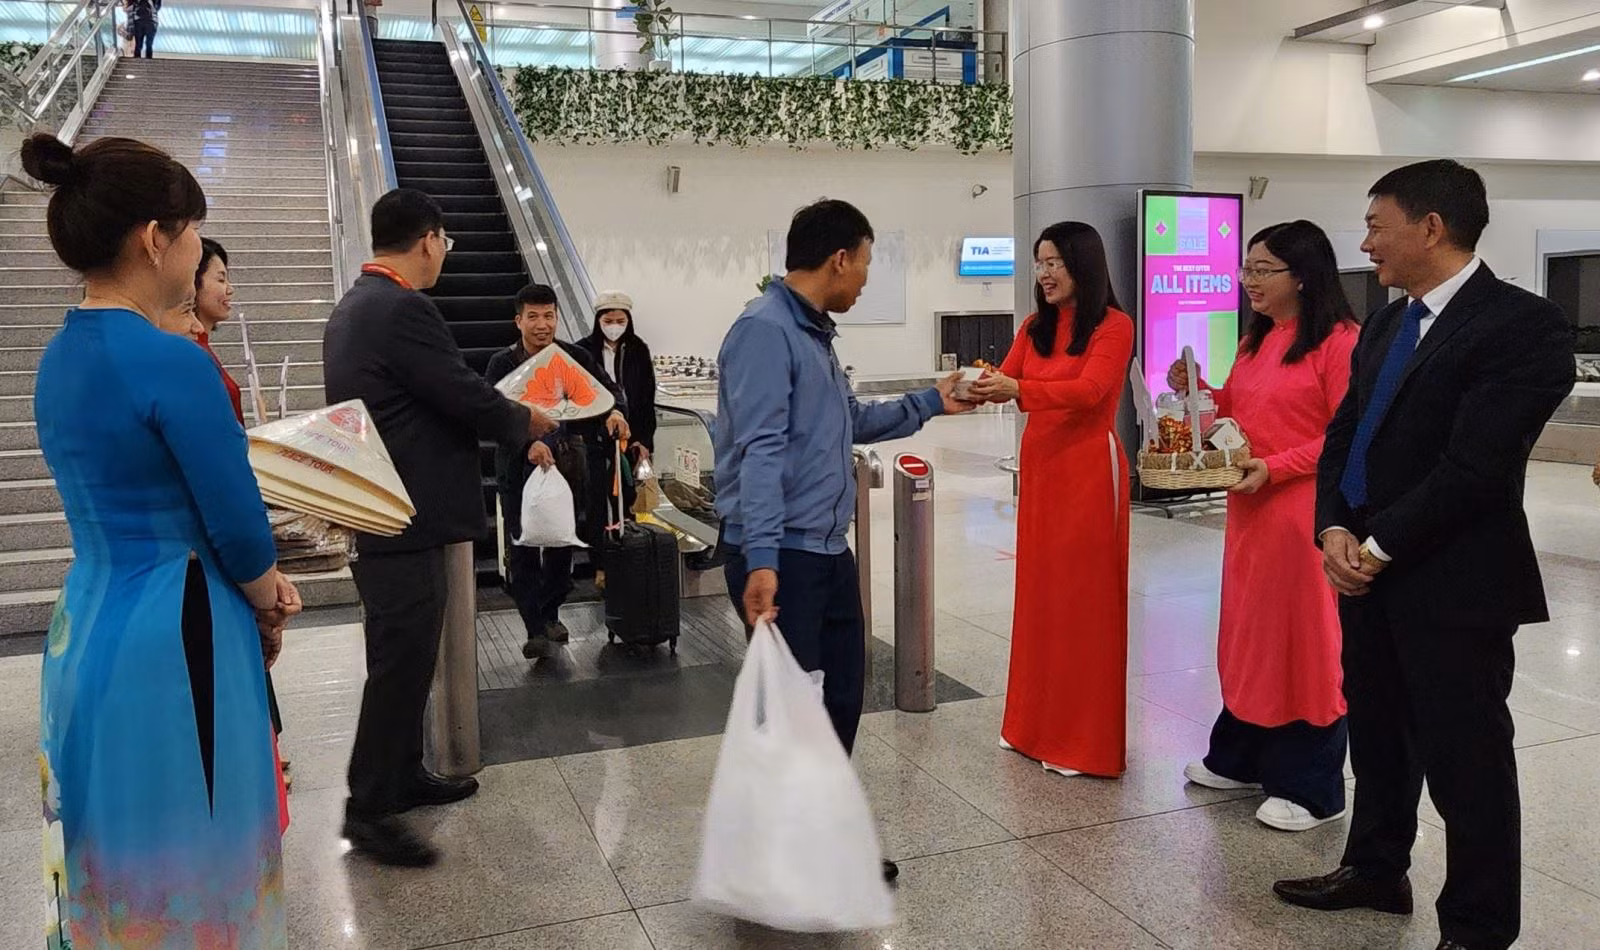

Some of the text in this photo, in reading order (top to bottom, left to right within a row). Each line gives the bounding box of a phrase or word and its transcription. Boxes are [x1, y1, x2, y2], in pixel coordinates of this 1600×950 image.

[1180, 238, 1206, 249] SALE
[971, 246, 990, 256] TIA
[1151, 274, 1232, 294] ALL ITEMS
[309, 459, 336, 474] TOUR
